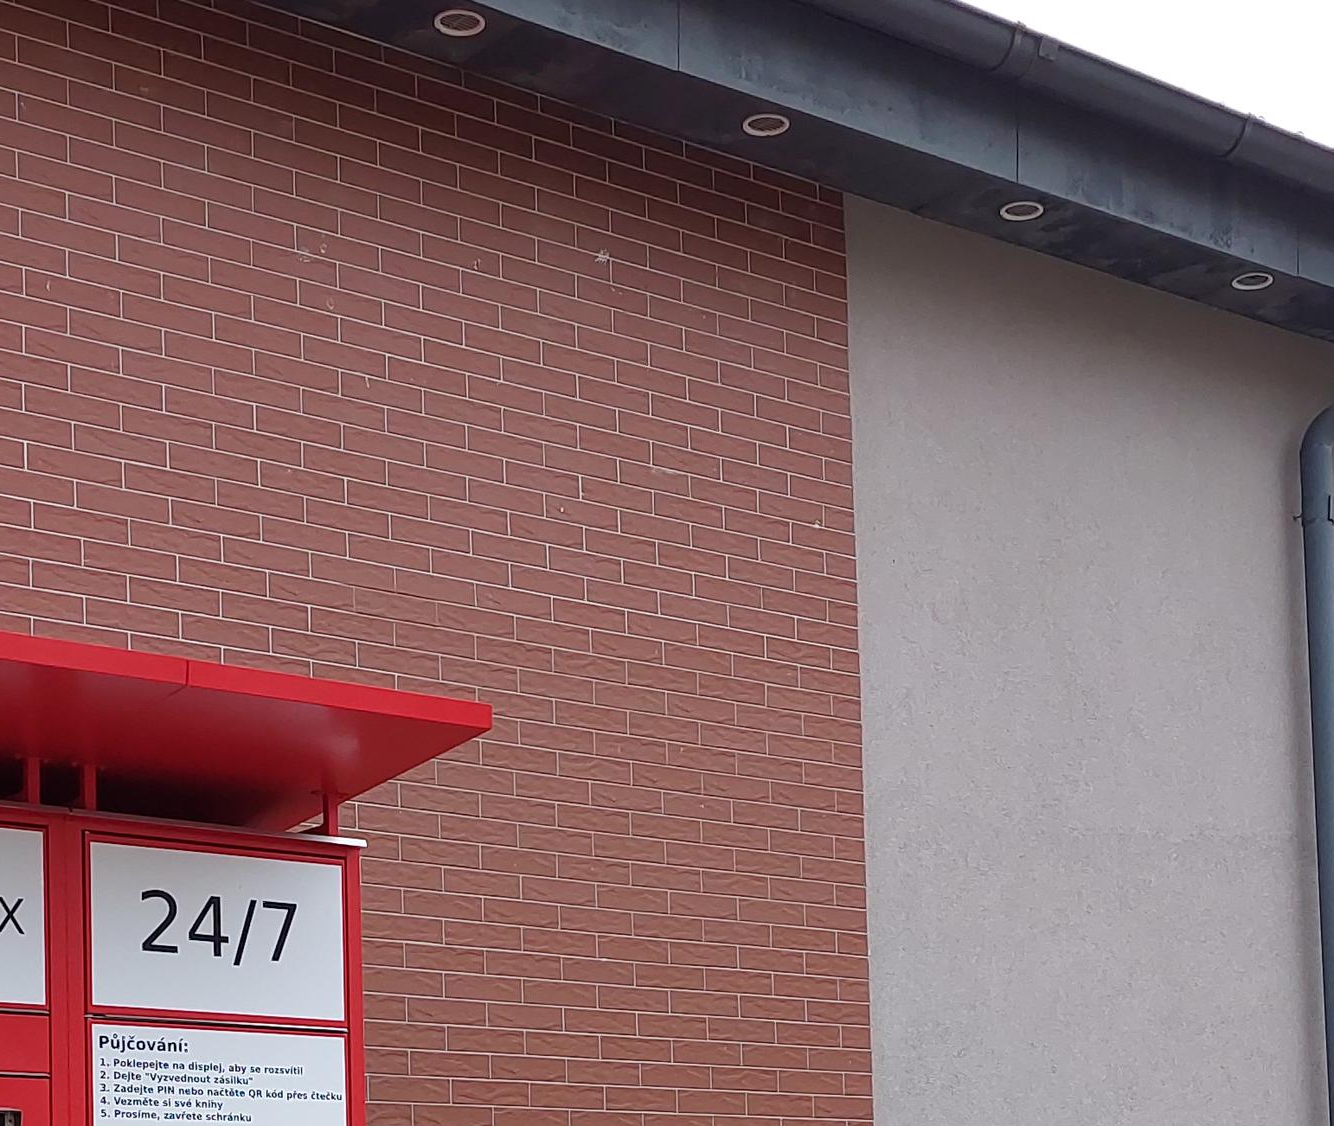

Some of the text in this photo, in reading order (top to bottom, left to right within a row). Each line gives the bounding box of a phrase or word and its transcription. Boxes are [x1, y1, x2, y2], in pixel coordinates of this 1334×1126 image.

[139, 889, 298, 967] 24/7
[98, 1033, 189, 1053] Půjčování:
[99, 1058, 303, 1075] 1. Poklepejte na displej, aby se rozsvítil
[100, 1071, 253, 1085] 2. Dejte "Vyzvednout zásilku"
[99, 1083, 343, 1101] 3. Zadejte PIN nebo načtěte QR kód přes čtečku
[100, 1096, 223, 1110] 4. Vezměte si své knihy
[100, 1108, 252, 1122] 5. Prosíme, zavřete schránku
